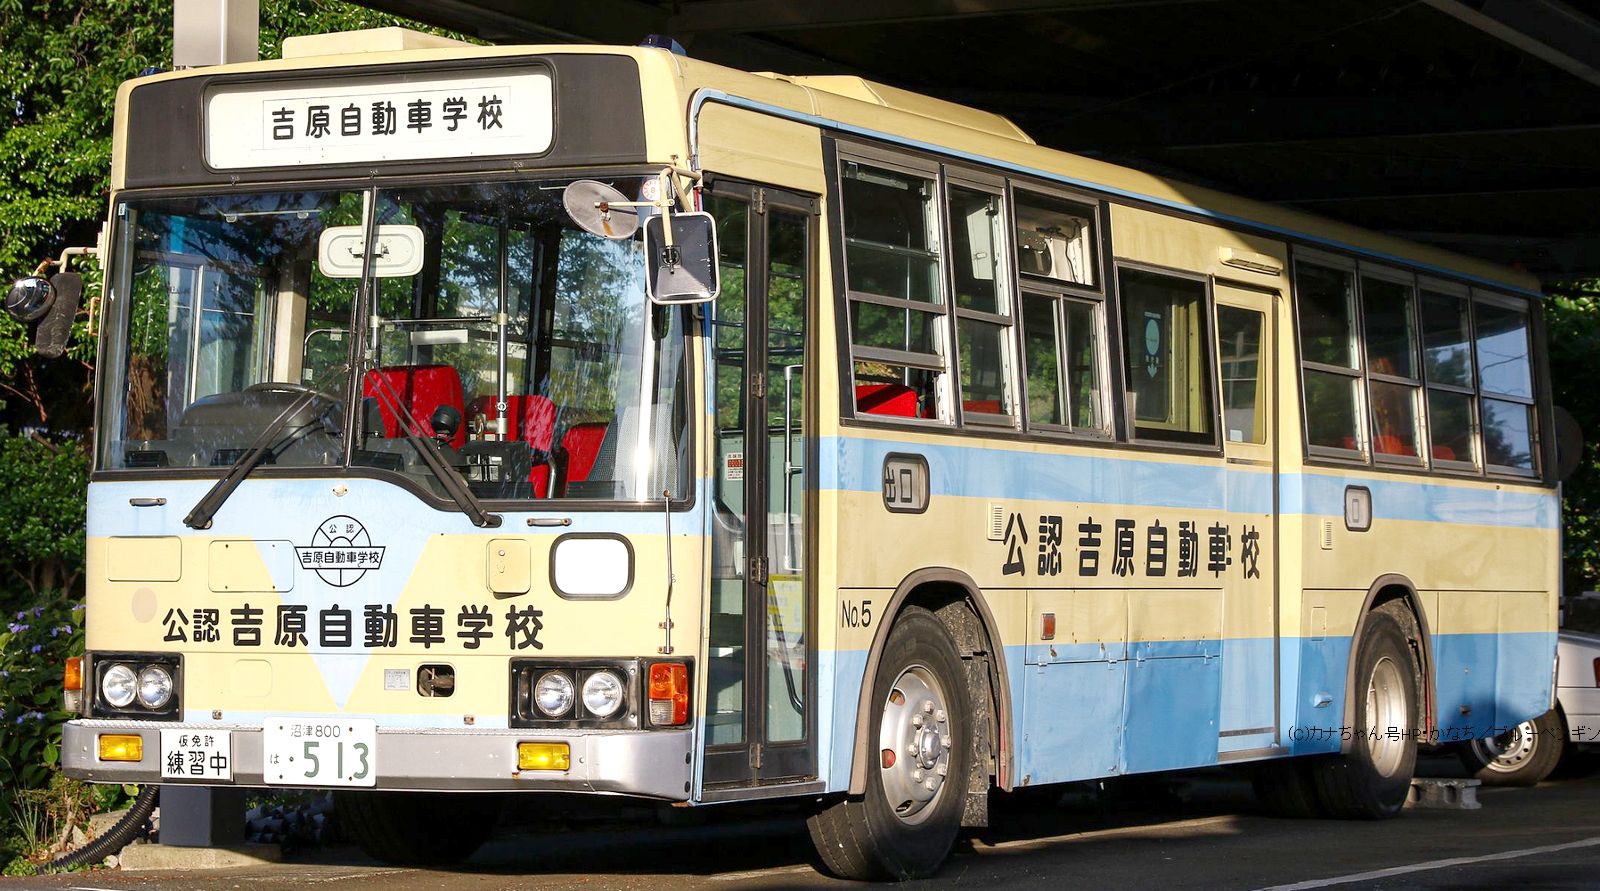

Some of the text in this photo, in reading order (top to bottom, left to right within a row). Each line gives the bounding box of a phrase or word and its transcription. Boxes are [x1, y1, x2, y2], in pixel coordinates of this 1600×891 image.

[271, 94, 504, 141] 吉原自動車学校
[885, 466, 912, 503] 出口
[302, 550, 380, 564] 吉原自動車学校
[162, 603, 545, 650] 公認吉原自動車学校
[841, 600, 872, 628] No.5
[178, 734, 215, 748] 仮免許
[167, 750, 227, 776] 練習中
